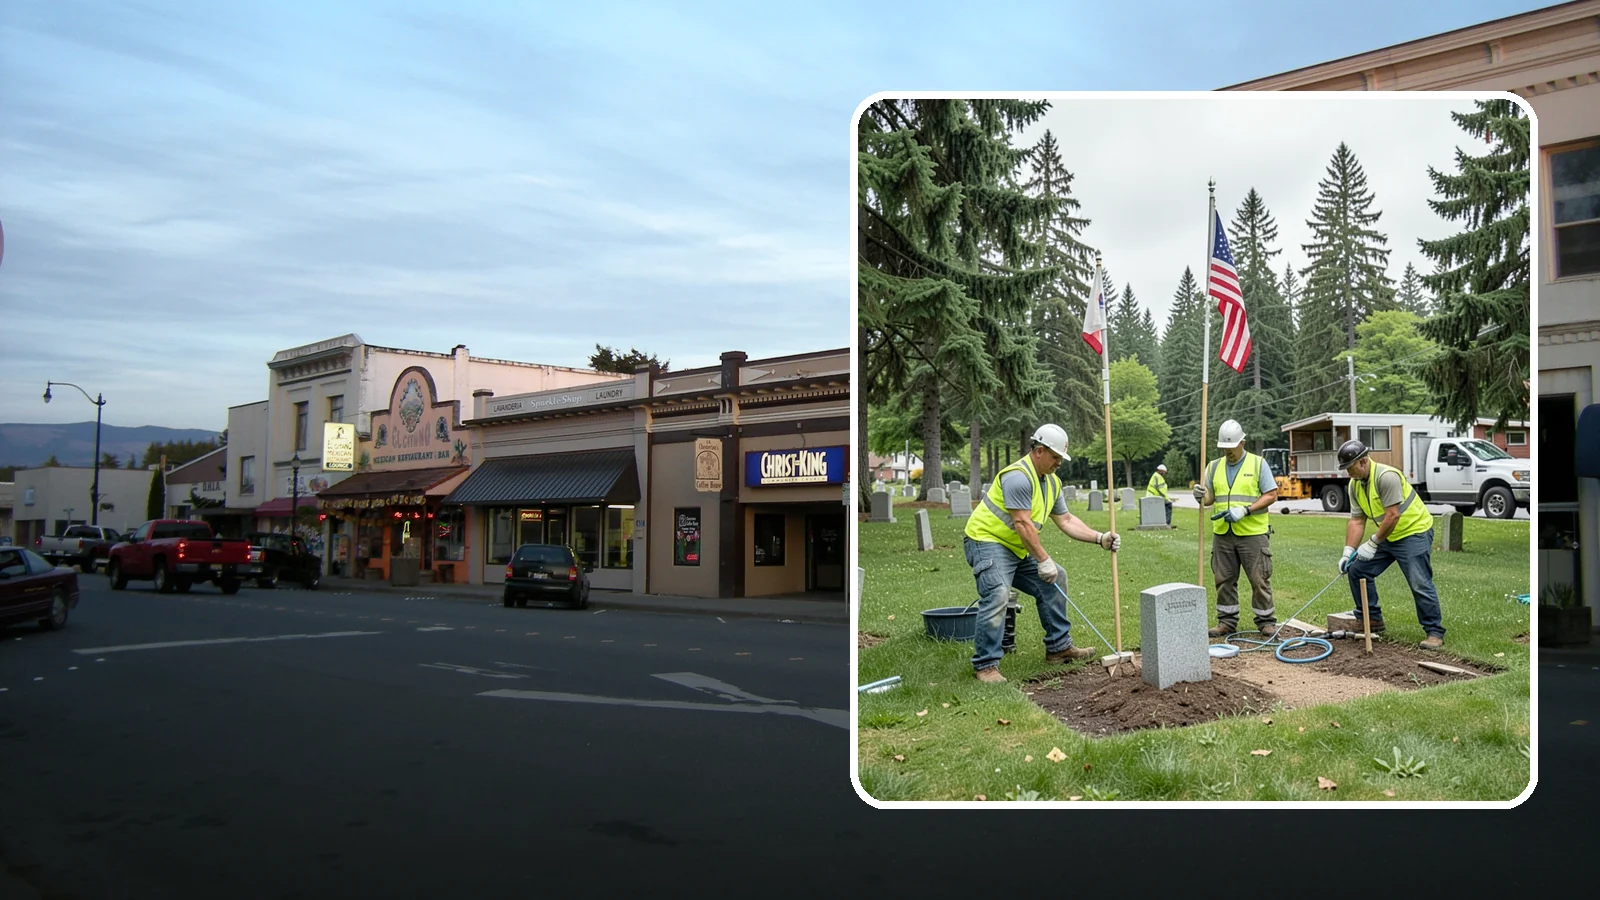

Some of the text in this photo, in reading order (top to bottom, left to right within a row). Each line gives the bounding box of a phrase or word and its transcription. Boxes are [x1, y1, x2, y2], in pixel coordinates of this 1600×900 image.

[562, 395, 582, 404] Shop
[595, 389, 623, 400] LAUNDRY
[493, 402, 522, 412] LAVANDERIA
[373, 450, 450, 464] MEXICAN RESTAURANT BAR
[761, 450, 827, 478] CHRIST KING
